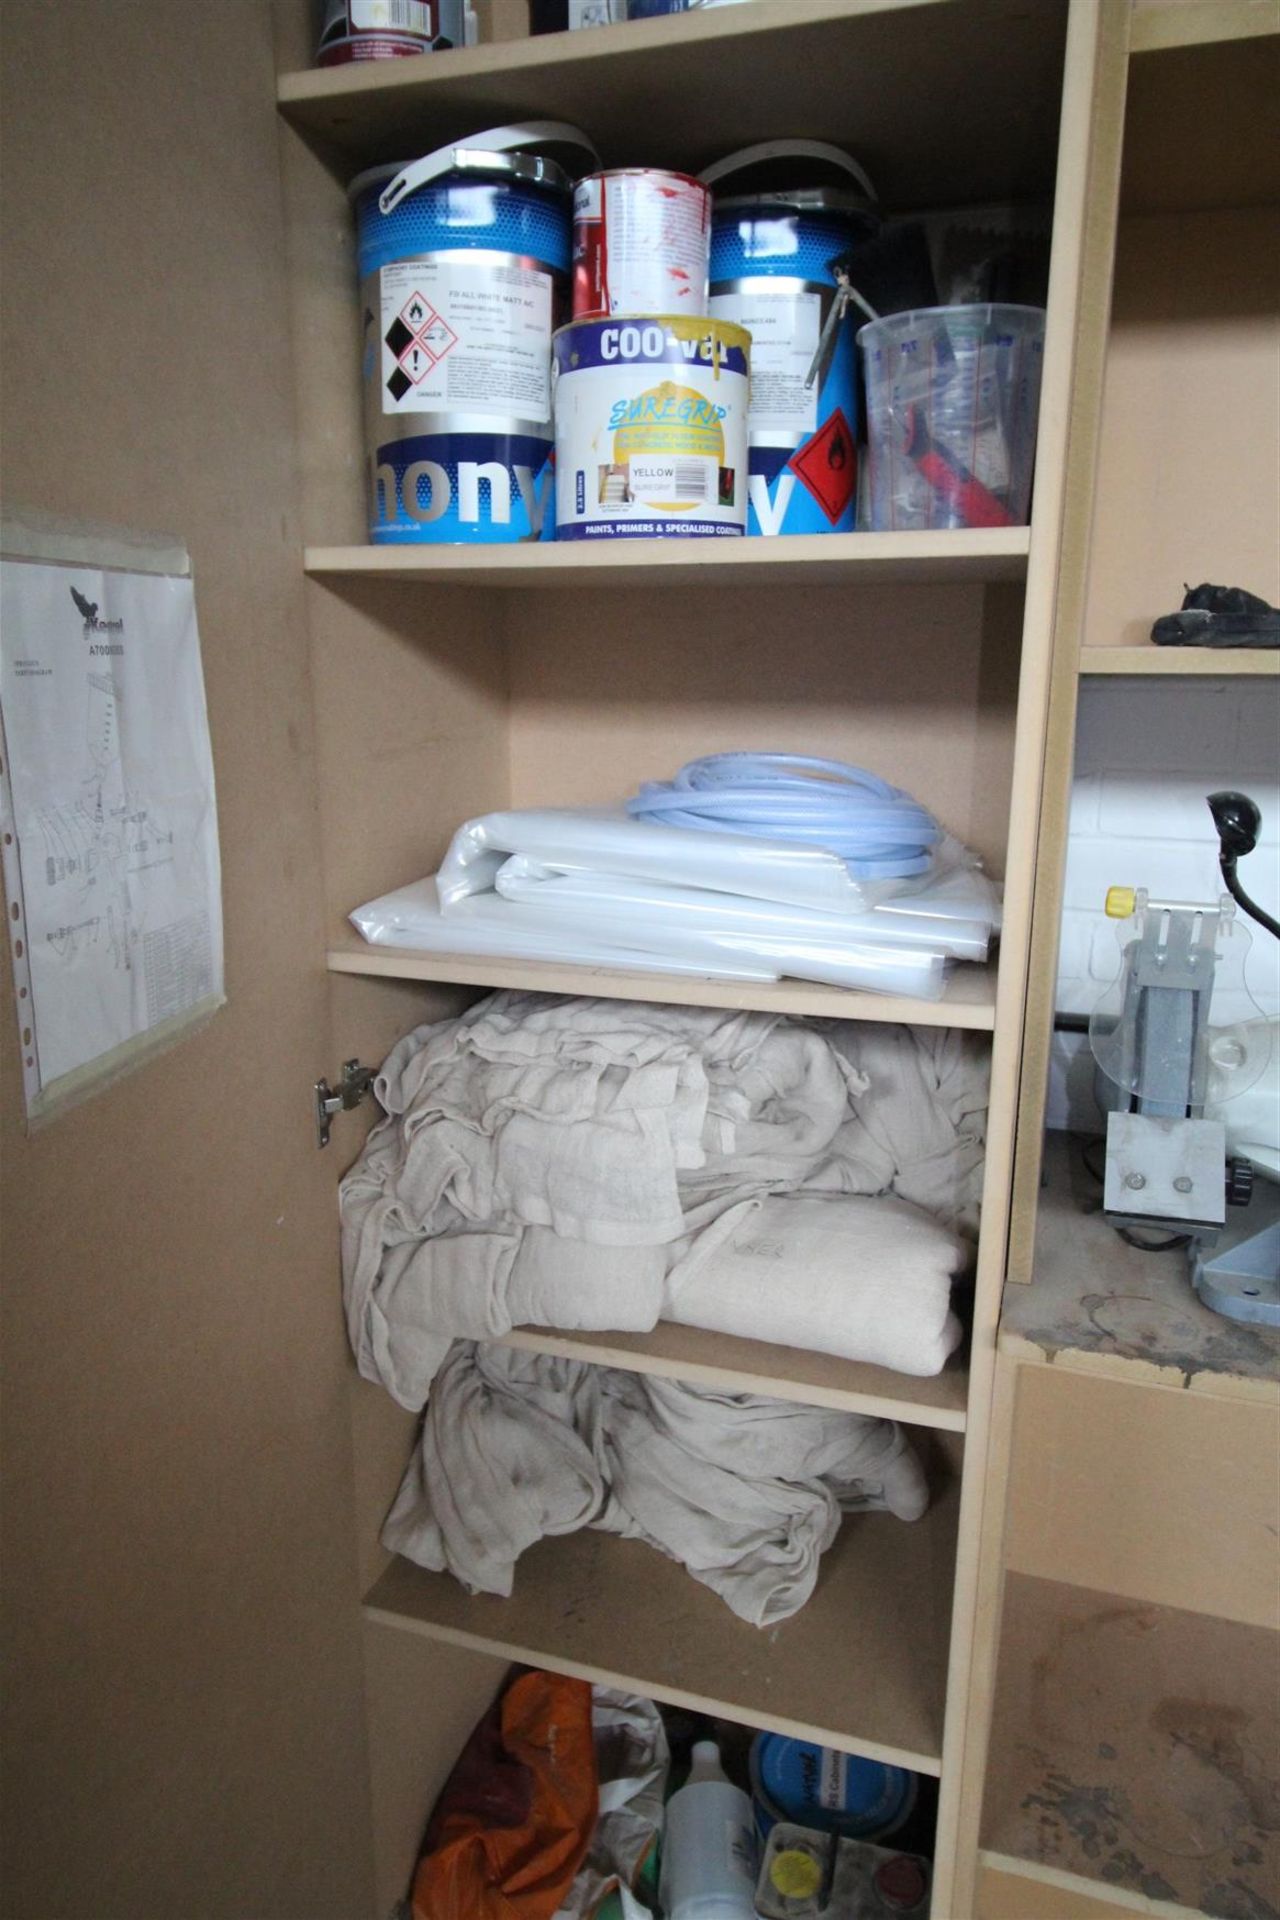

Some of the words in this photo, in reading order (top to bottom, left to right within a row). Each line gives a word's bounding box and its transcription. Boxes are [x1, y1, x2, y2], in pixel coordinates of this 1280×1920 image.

[633, 467, 674, 477] YELLOW
[586, 525, 614, 535] PAINTS,
[616, 523, 653, 533] PRIMERS
[656, 523, 663, 532] &
[665, 523, 715, 534] SPECIALISED
